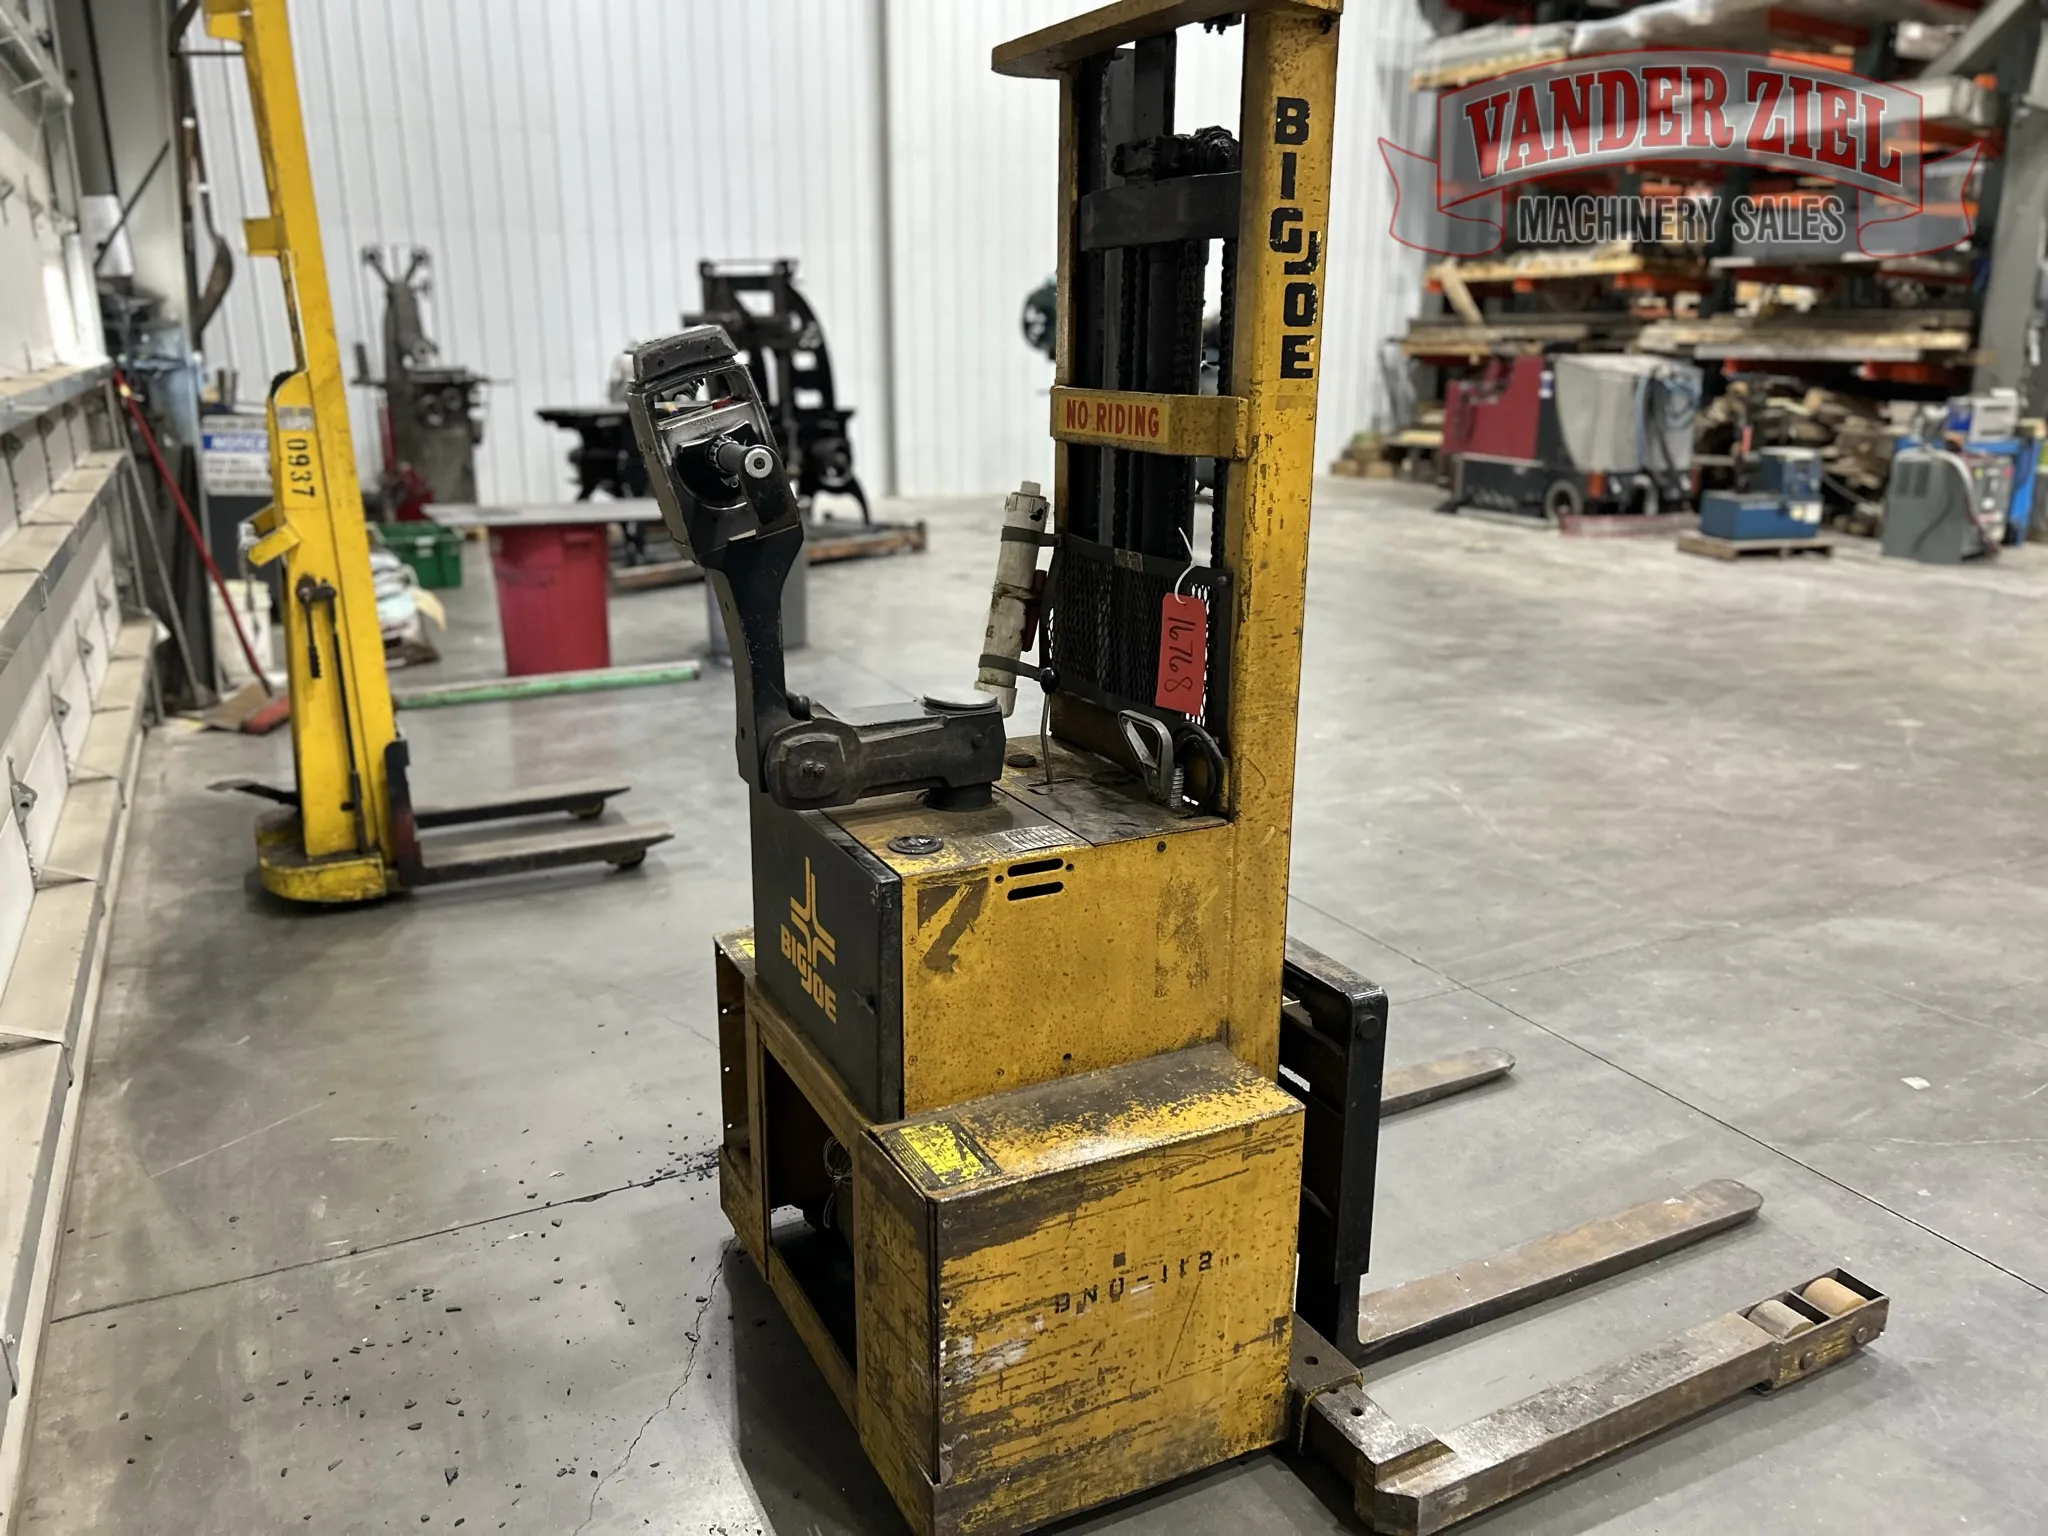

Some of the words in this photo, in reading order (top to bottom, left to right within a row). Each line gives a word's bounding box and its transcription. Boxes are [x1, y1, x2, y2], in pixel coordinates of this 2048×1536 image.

[1066, 399, 1089, 430] NO
[1096, 404, 1160, 438] RIDING
[286, 438, 316, 497] 0937
[1164, 616, 1197, 693] 16768
